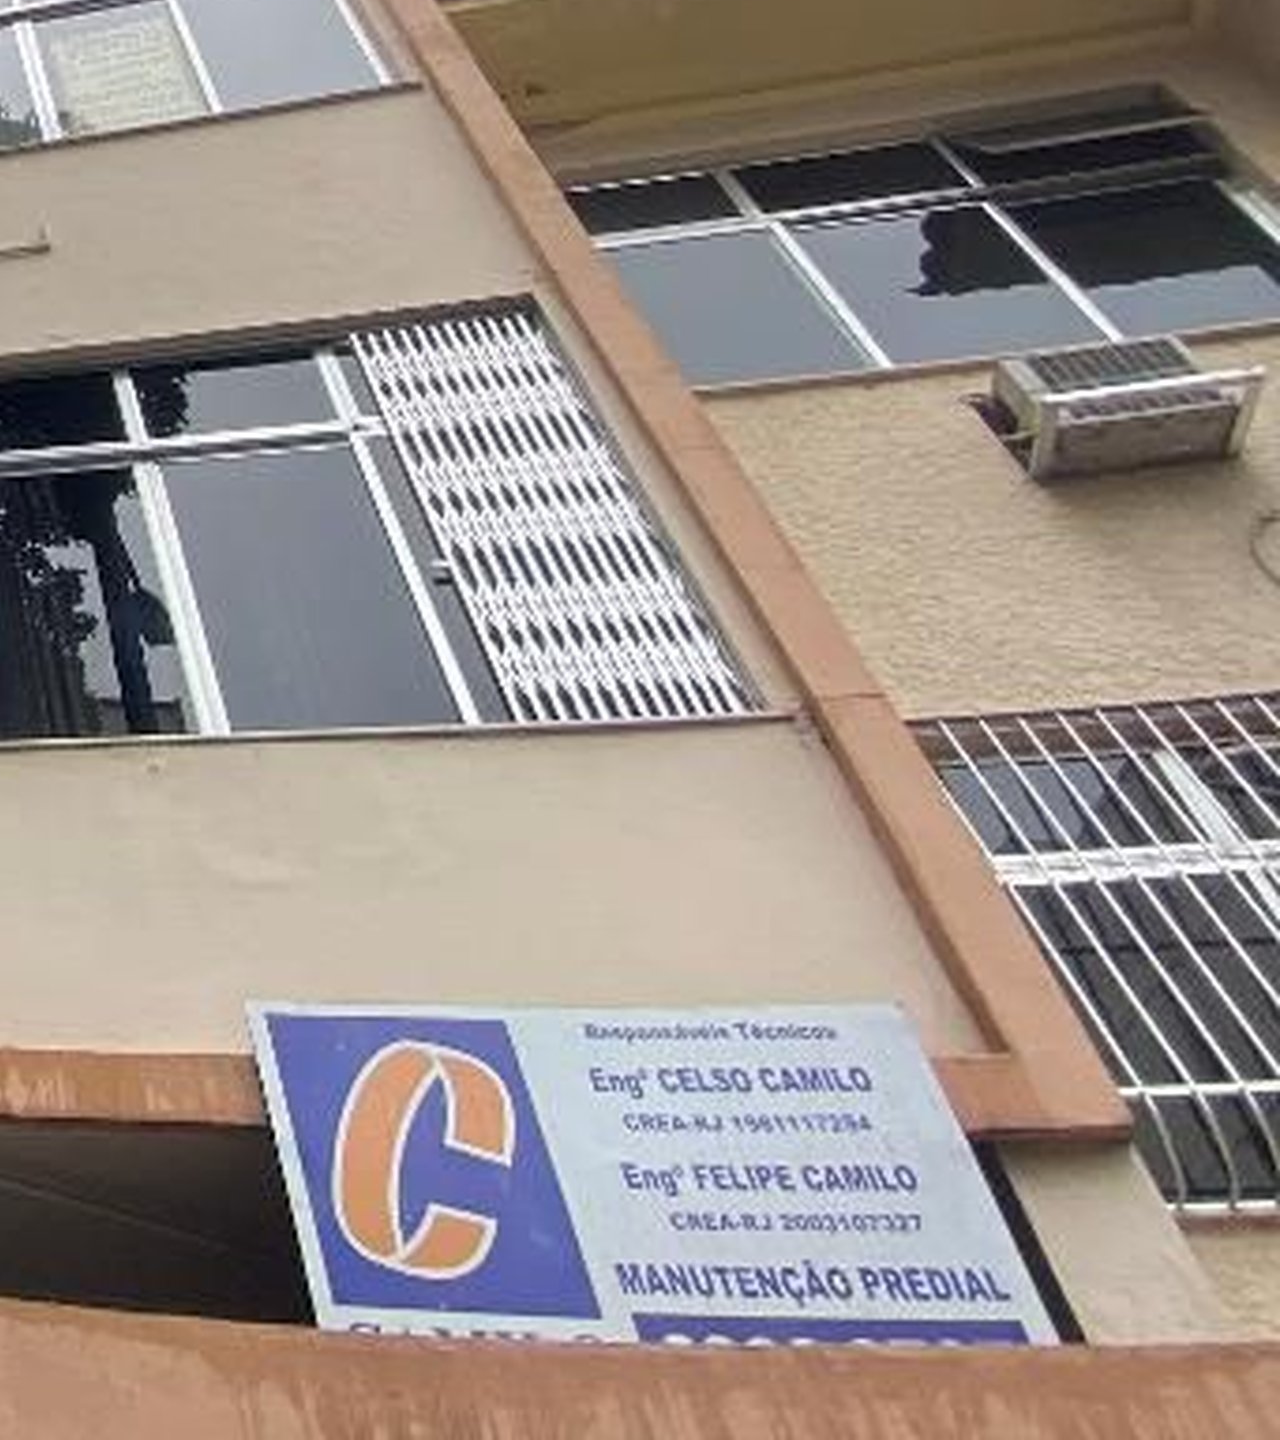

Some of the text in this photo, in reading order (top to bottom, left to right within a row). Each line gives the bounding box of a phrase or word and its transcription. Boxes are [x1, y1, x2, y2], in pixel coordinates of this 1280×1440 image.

[657, 1067, 752, 1093] CELSO
[758, 1067, 873, 1093] CAMILO
[692, 1164, 798, 1191] FELIPE
[801, 1164, 919, 1192] CAMILO
[615, 1260, 1012, 1307] MANUTENÇÃO PREDIAL
